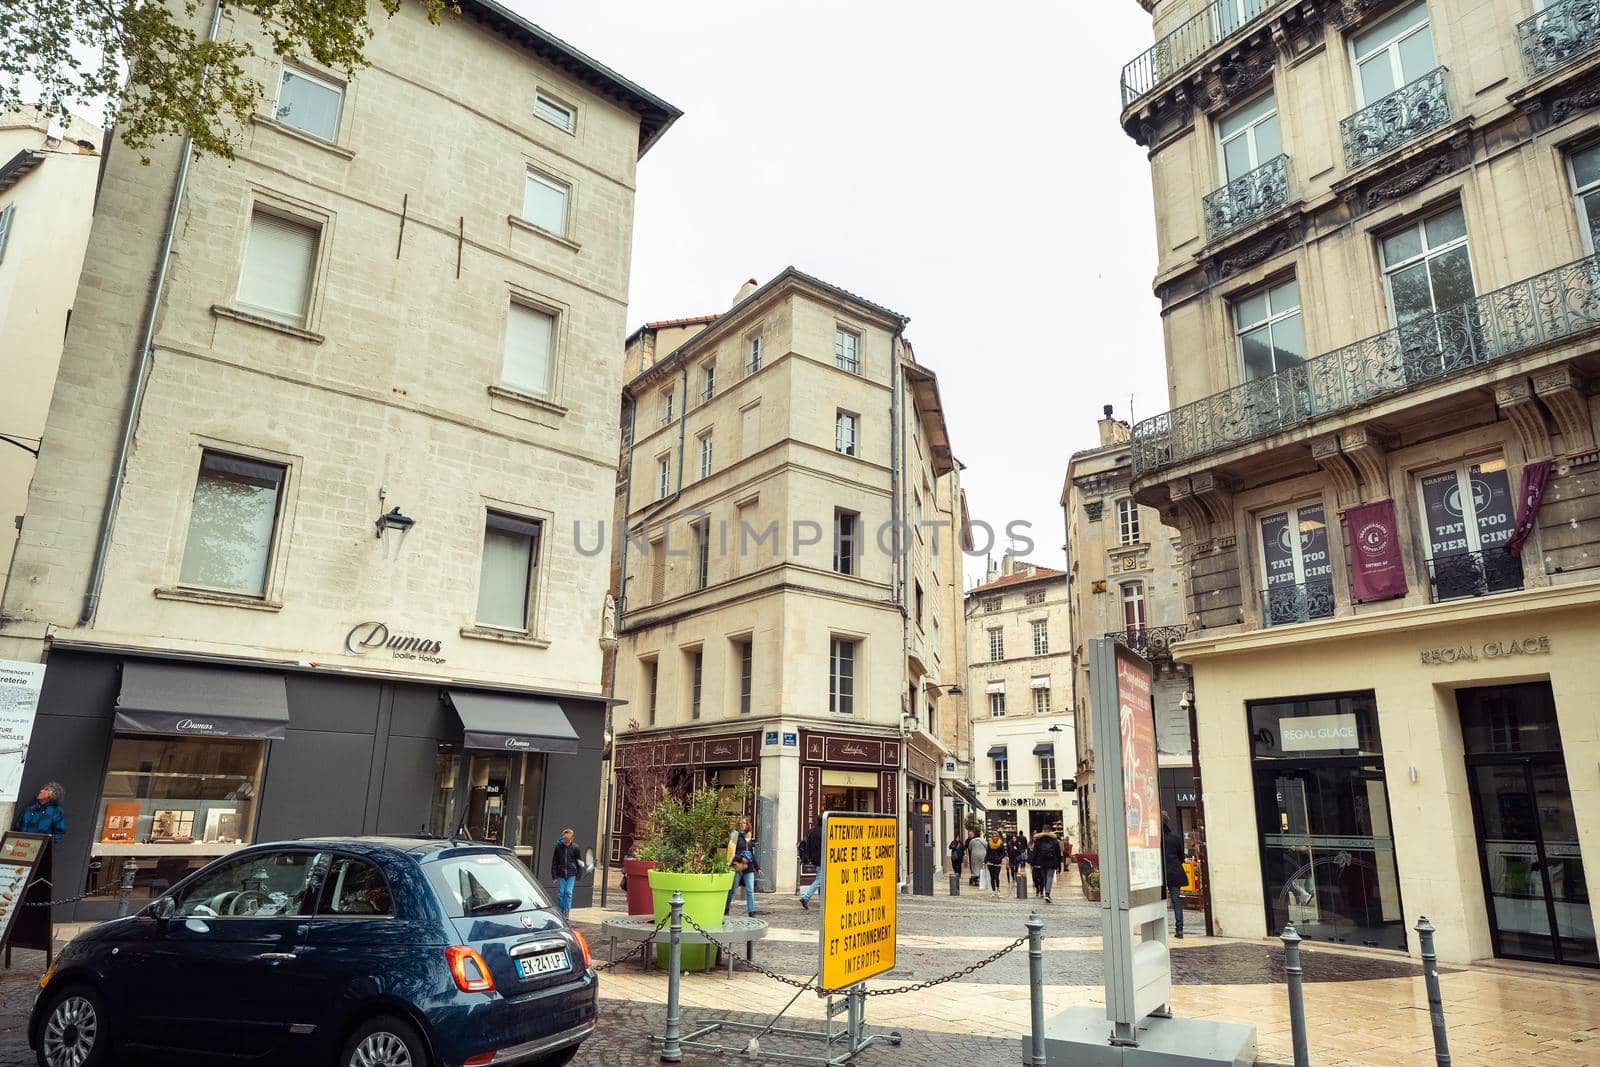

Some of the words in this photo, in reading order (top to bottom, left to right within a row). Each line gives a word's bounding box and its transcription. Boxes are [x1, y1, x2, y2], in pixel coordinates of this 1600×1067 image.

[1423, 473, 1456, 486] GRAPHIC
[345, 621, 442, 655] Dumas
[419, 653, 446, 664] Horloger
[1421, 645, 1479, 664] REGAL
[1483, 635, 1550, 660] GLACE
[176, 719, 213, 731] Dumas
[1283, 729, 1316, 740] REGAL
[1318, 727, 1356, 738] GLACE
[996, 798, 1046, 807] KONSORTIUM
[829, 825, 864, 840] ATTENTION
[868, 825, 896, 840] TRAVAUX
[830, 847, 848, 863] PLACE
[851, 847, 858, 861] ET
[862, 846, 871, 860] RUE
[875, 844, 895, 859] CARNOT
[841, 869, 849, 884] DU
[853, 868, 859, 882] 11
[862, 864, 884, 881] FÉVRIER
[846, 890, 854, 906] AU
[858, 888, 866, 903] 26
[870, 886, 881, 901] JUIN
[840, 905, 886, 930] CIRCULATION
[830, 938, 839, 956] ET
[844, 924, 892, 952] STATIONNEMENT
[844, 949, 880, 975] INTERDITS
